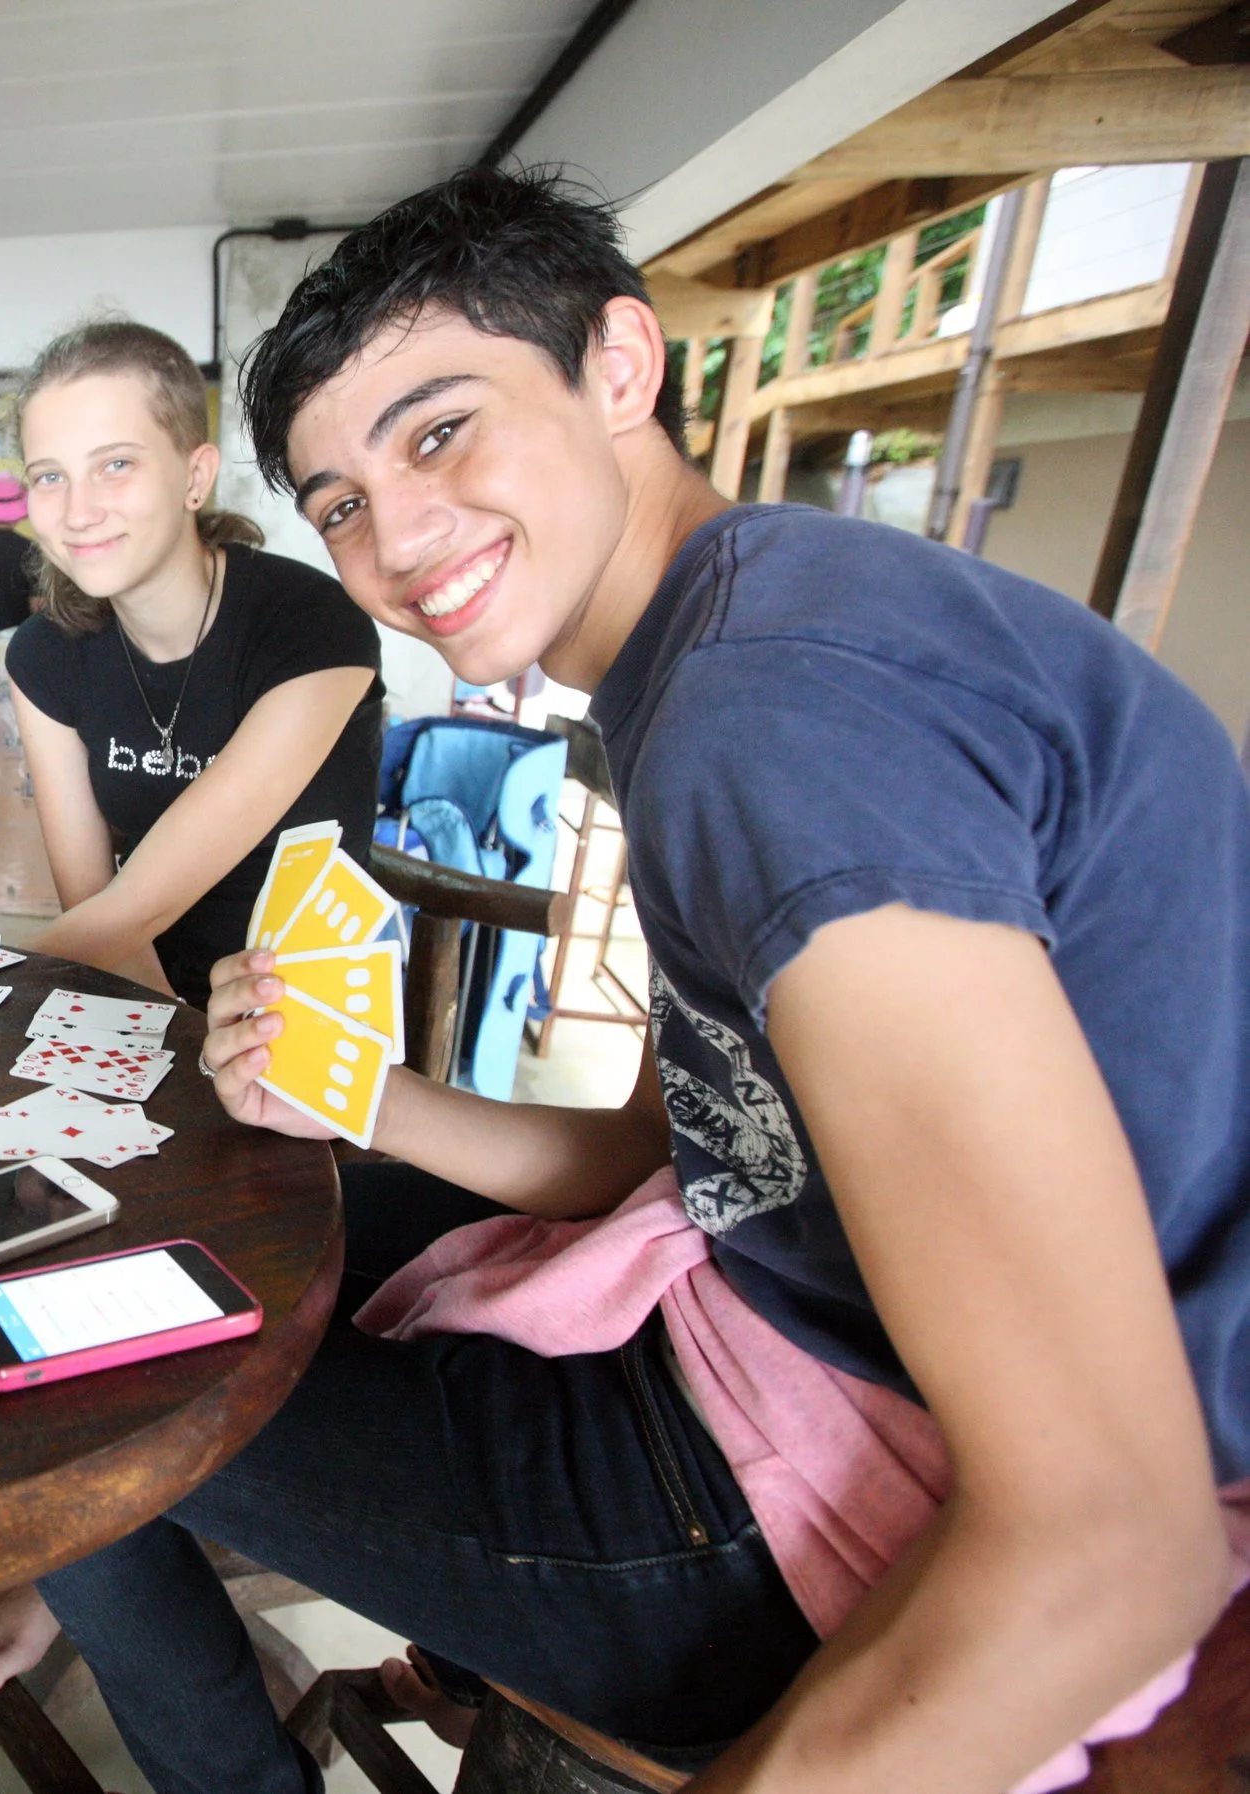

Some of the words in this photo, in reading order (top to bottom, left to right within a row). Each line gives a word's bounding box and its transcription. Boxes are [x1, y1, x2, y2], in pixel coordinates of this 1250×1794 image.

[24, 1054, 39, 1063] 10
[19, 1065, 35, 1075] 10
[132, 1074, 148, 1083] 10
[56, 1088, 68, 1097] A
[128, 1087, 144, 1097] 10
[121, 1106, 136, 1114] A
[150, 1127, 161, 1135] A
[3, 1148, 18, 1156] A
[134, 1144, 150, 1152] A
